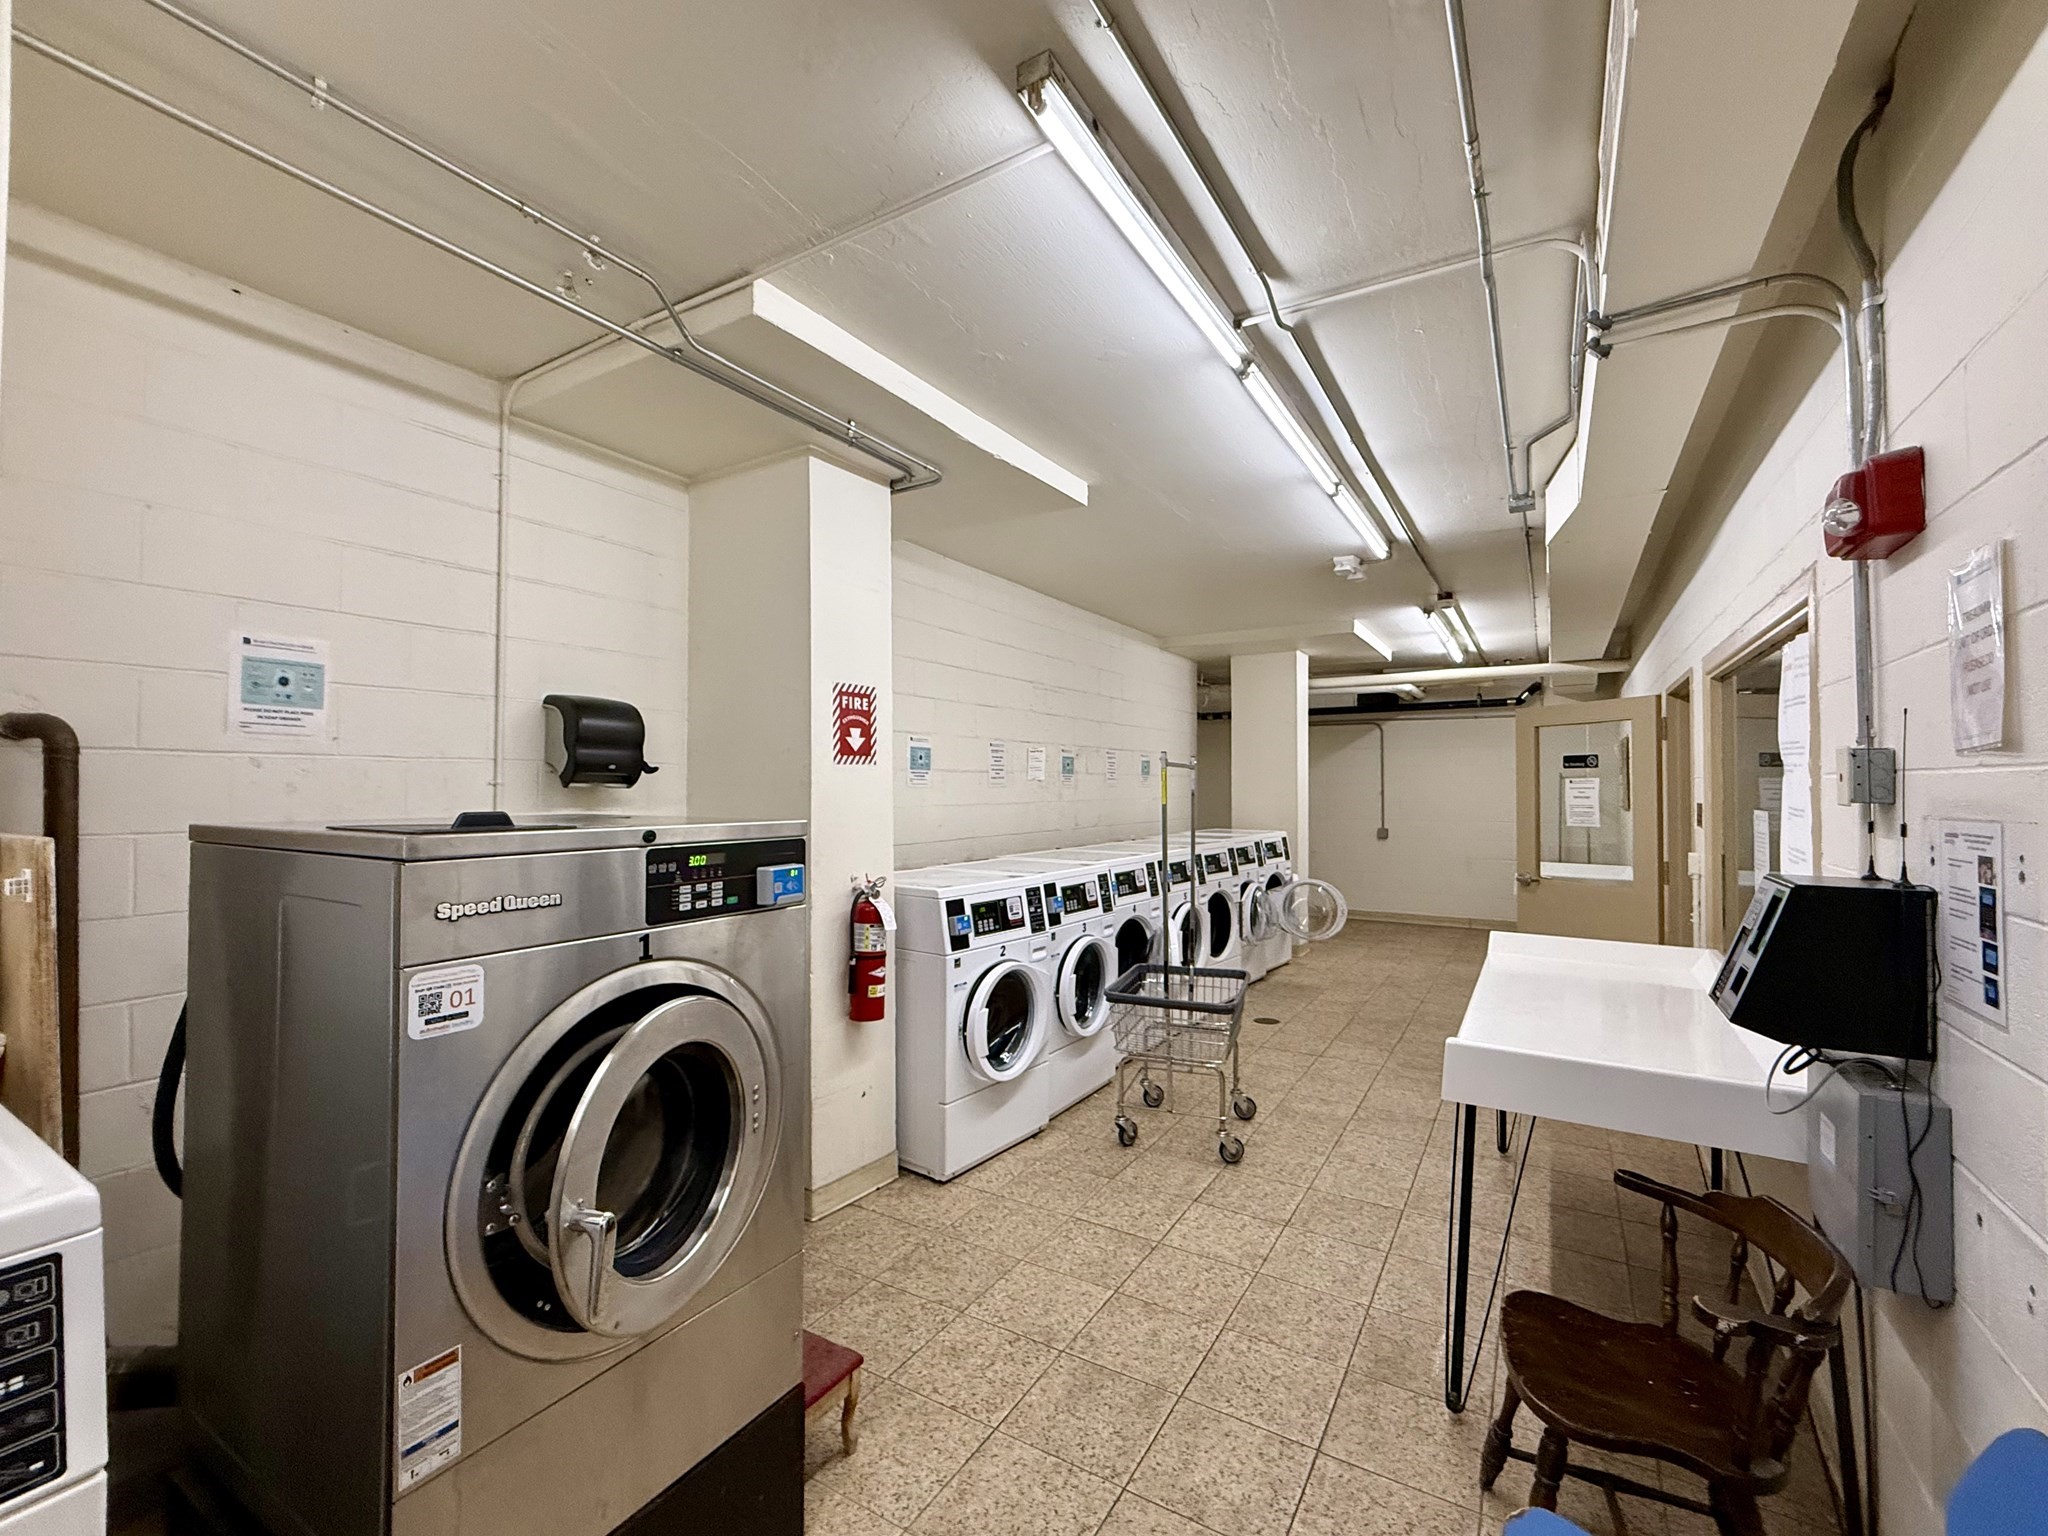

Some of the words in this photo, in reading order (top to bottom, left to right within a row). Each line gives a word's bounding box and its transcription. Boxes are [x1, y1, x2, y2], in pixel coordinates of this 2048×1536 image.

[842, 695, 869, 711] FIRE
[435, 895, 503, 921] Speed
[503, 892, 562, 911] Queen
[1081, 922, 1087, 933] 3
[639, 933, 653, 961] 1
[999, 945, 1006, 957] 2
[450, 988, 476, 1009] 01
